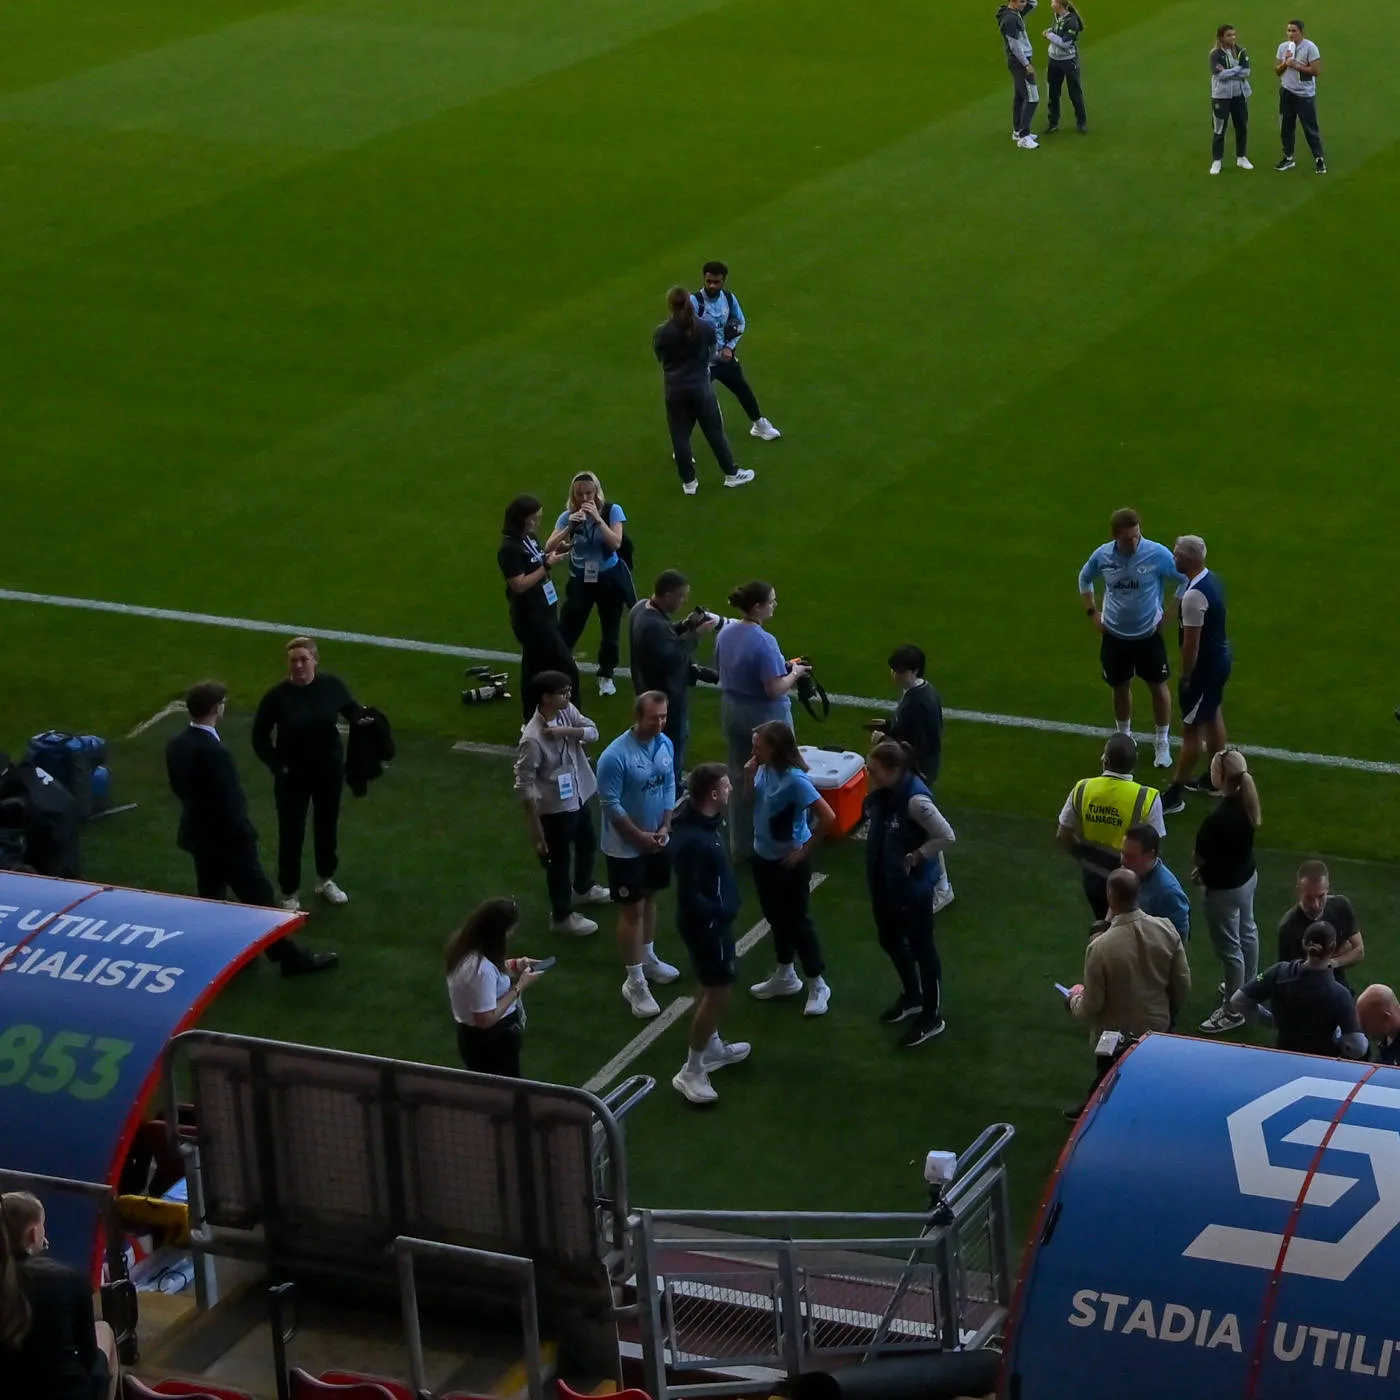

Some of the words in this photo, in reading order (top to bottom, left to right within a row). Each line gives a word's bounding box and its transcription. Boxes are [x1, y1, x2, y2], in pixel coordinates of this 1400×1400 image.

[1085, 813, 1123, 827] MANAGER
[1088, 804, 1120, 817] TUNNEL
[17, 909, 184, 949] UTILITY
[1067, 1288, 1243, 1353] STADIA
